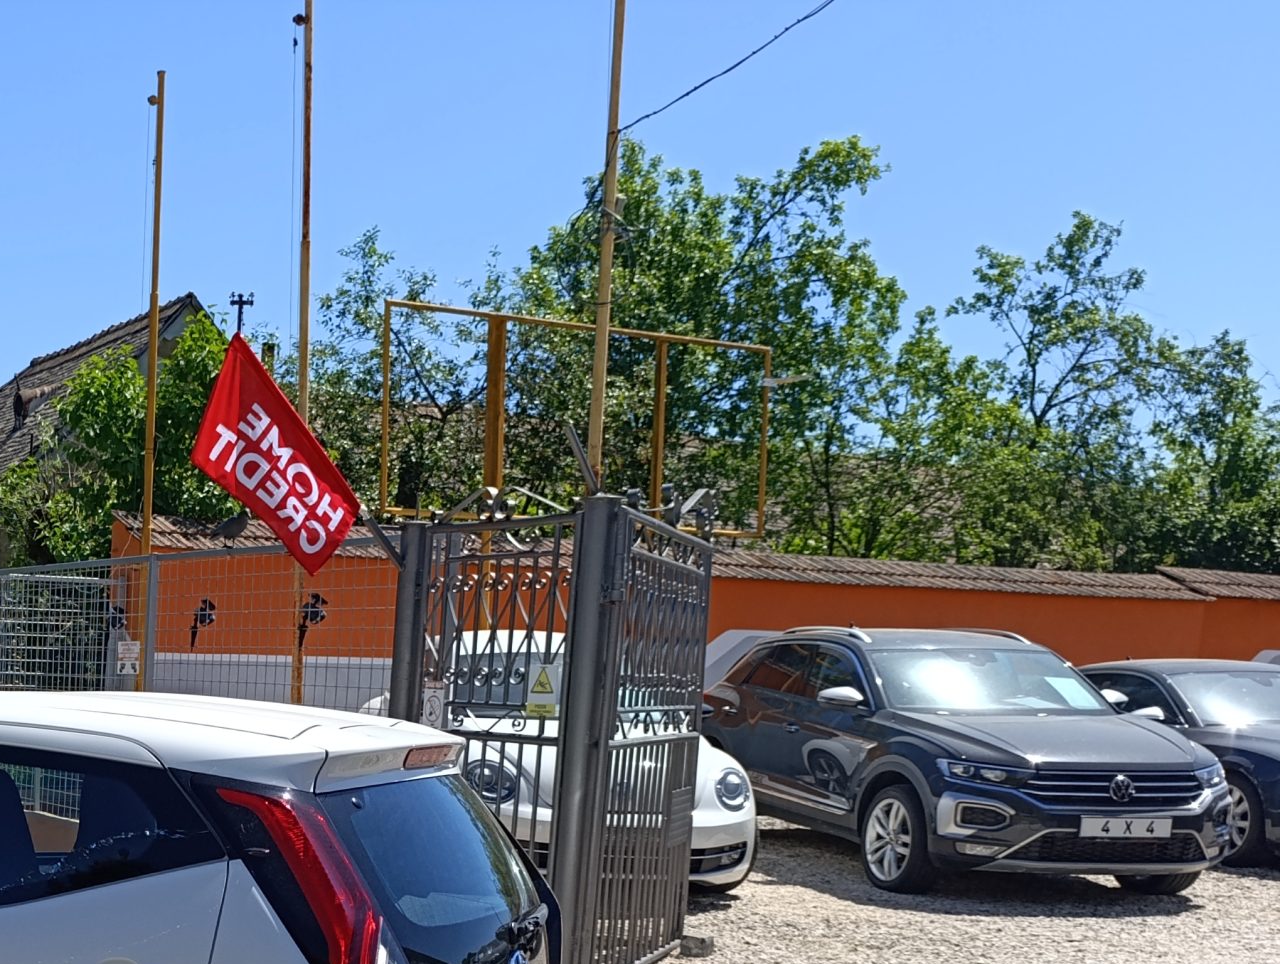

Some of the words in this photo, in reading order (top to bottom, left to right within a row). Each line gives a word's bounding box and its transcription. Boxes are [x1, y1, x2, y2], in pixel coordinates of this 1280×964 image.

[1100, 819, 1111, 835] 4
[1122, 819, 1134, 835] X
[1145, 820, 1155, 835] 4
